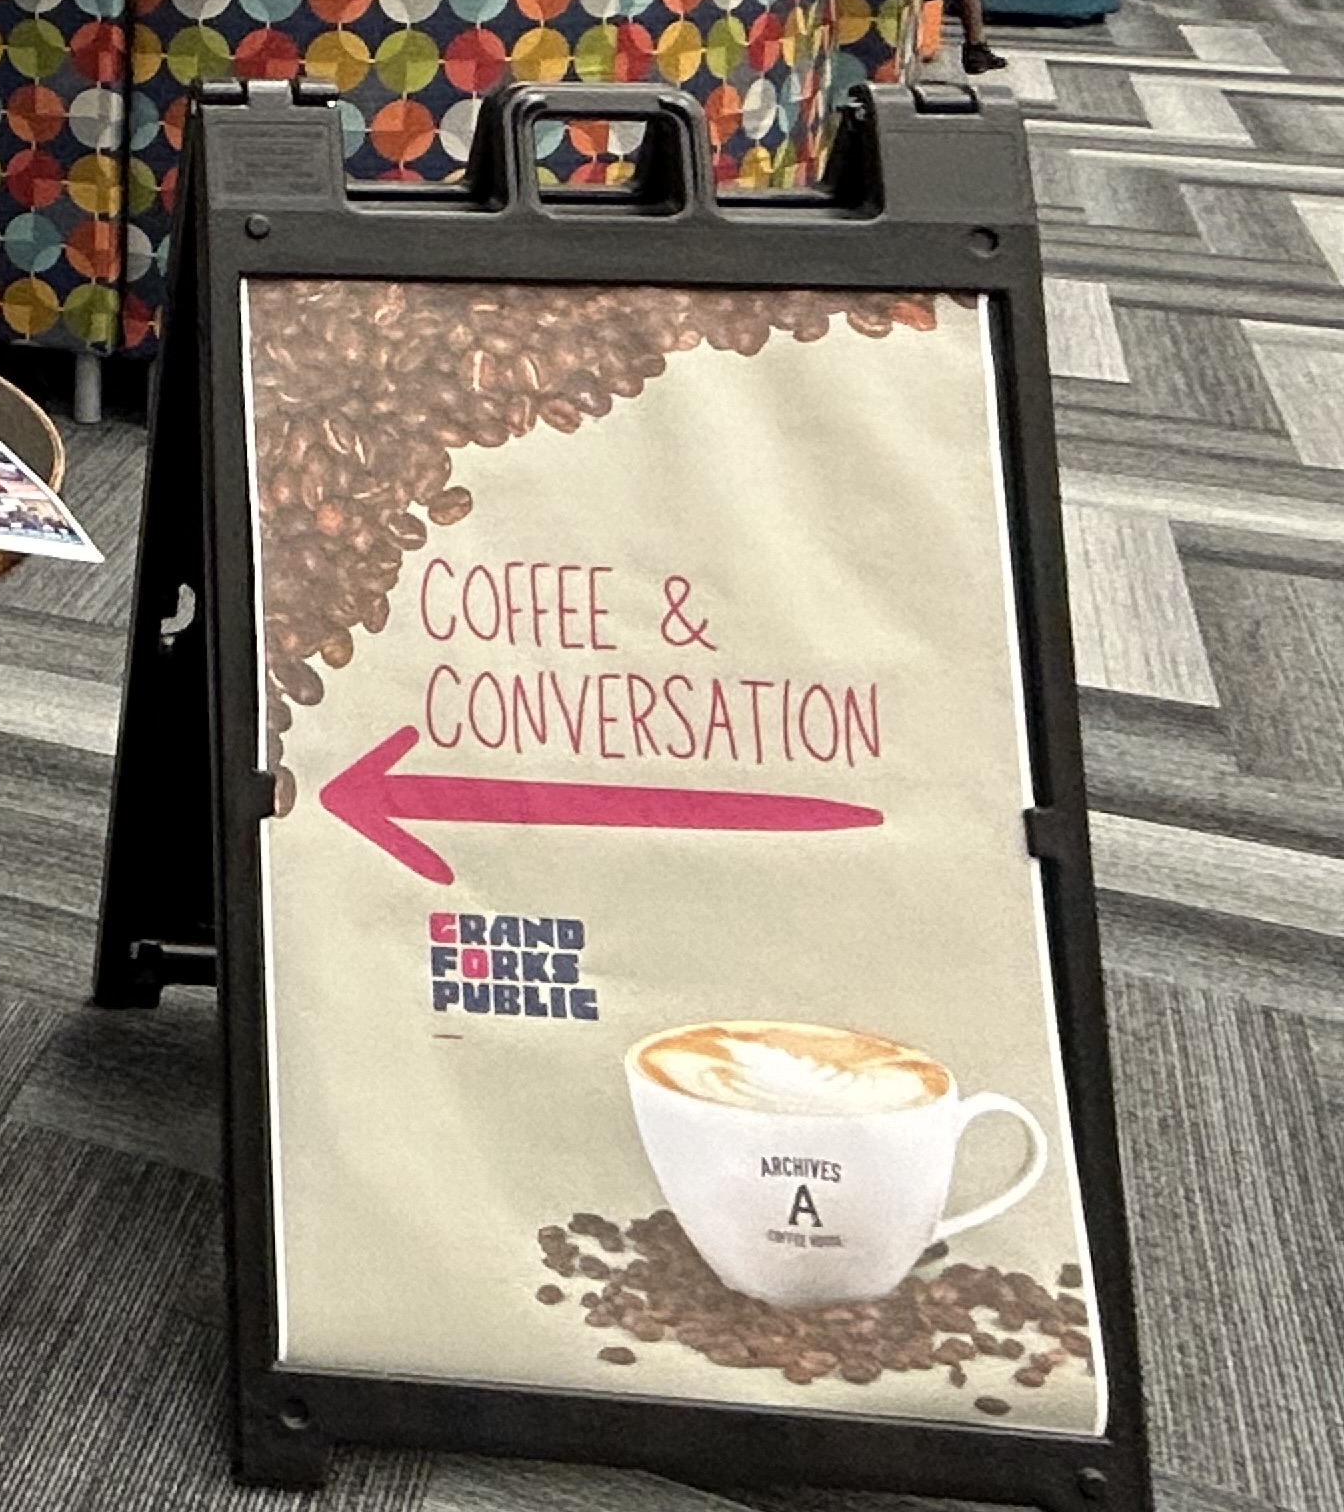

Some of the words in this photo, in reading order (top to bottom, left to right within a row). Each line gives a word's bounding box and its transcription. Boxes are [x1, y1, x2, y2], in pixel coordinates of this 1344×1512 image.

[420, 557, 618, 652] COFFEE
[660, 574, 719, 652] &
[425, 664, 881, 768] CONVERSATION
[429, 911, 586, 950] GRAND
[430, 947, 580, 984] FORKS
[432, 981, 599, 1021] PUBLIC
[760, 1156, 842, 1183] ARCHIVES
[787, 1184, 824, 1228] A
